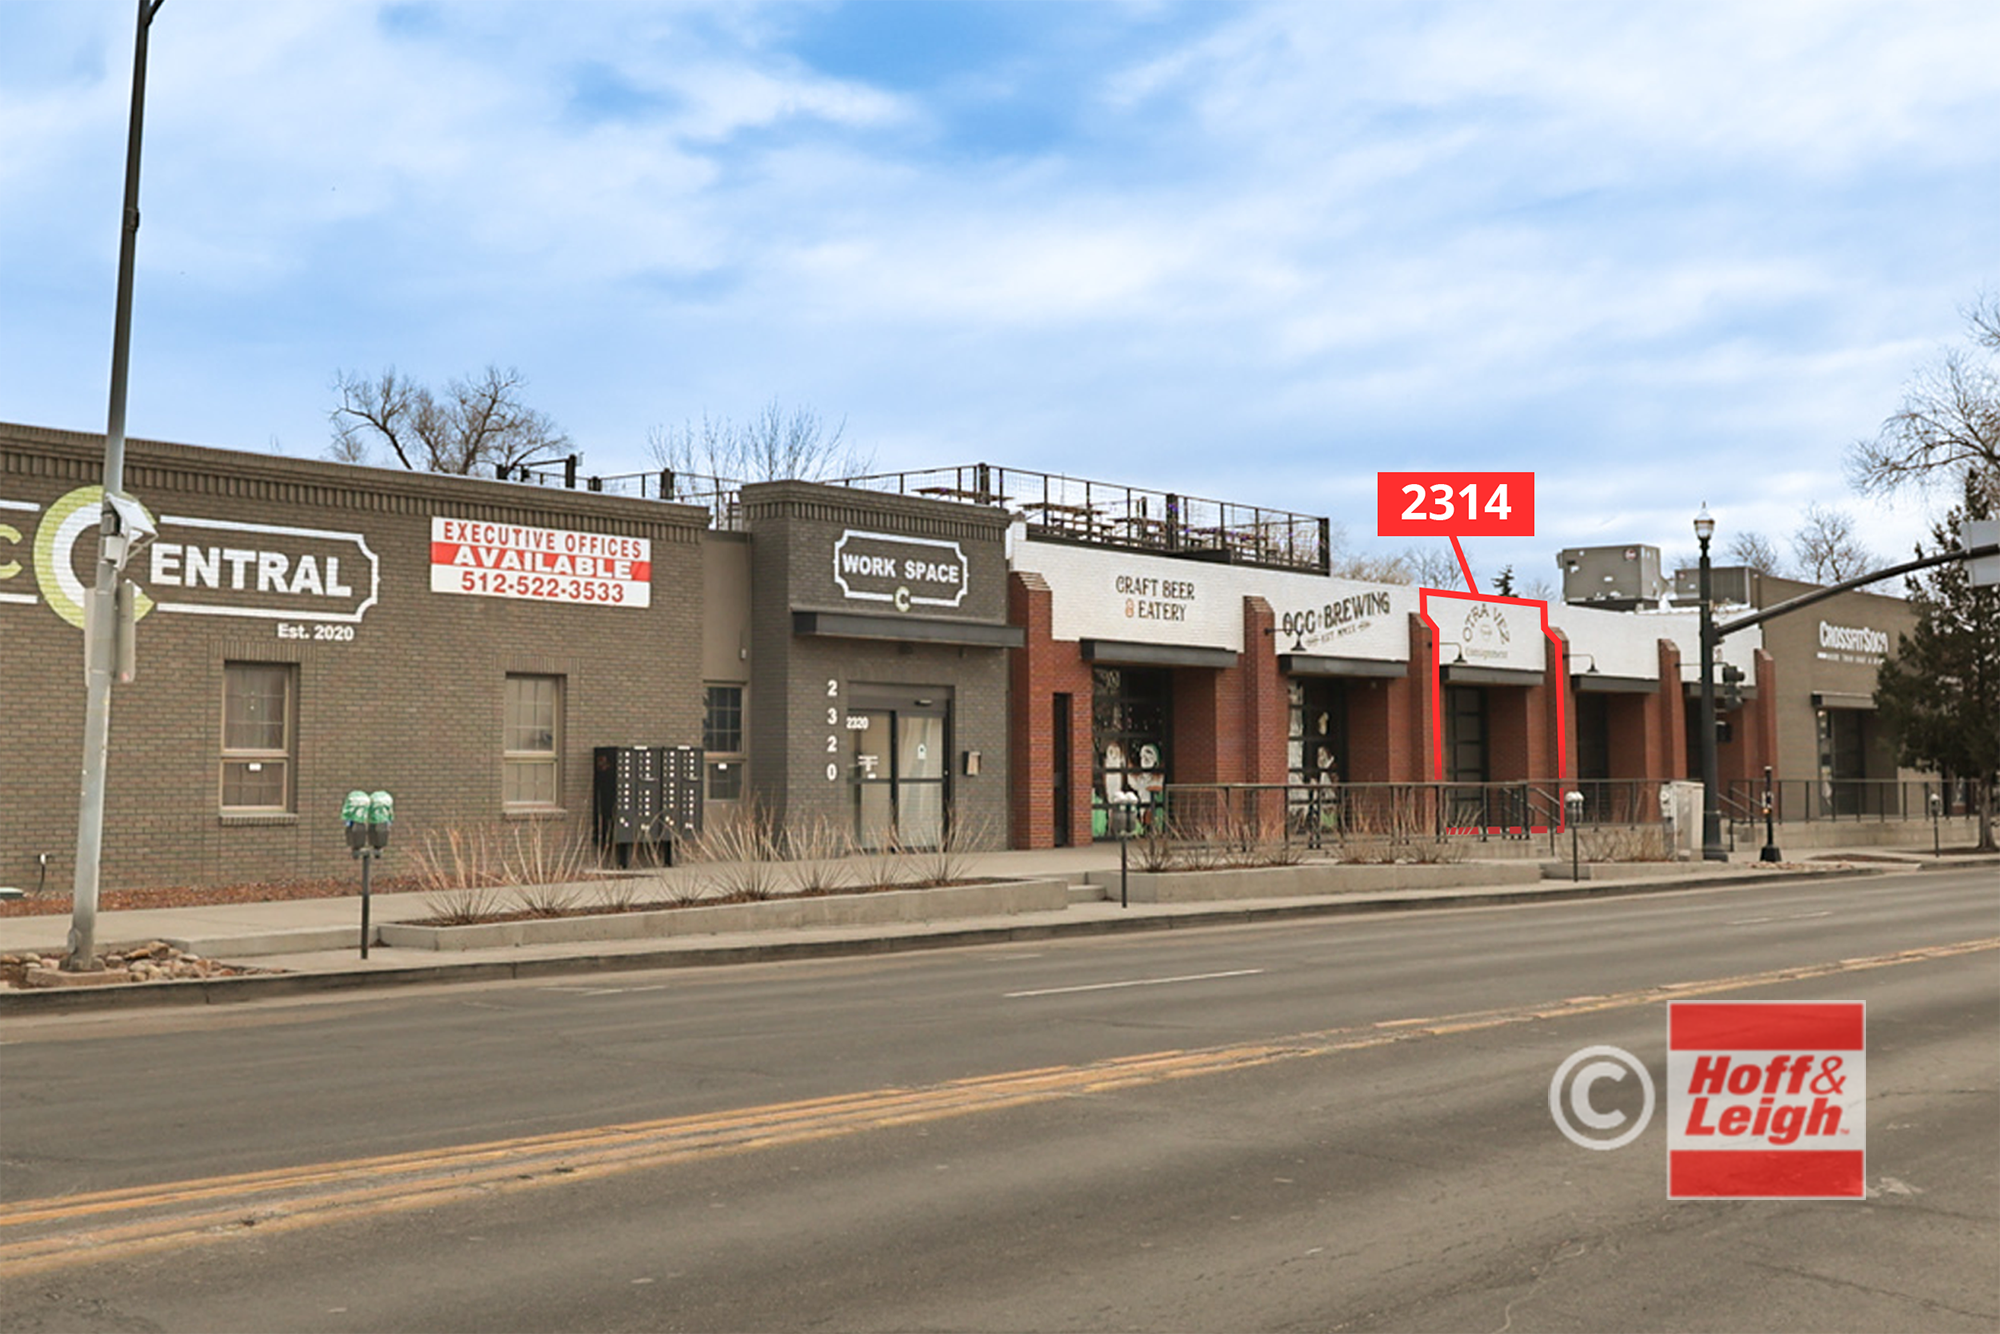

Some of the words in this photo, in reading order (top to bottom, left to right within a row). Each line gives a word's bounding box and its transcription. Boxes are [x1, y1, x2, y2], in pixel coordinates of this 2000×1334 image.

[444, 521, 556, 551] EXECUTIVE
[564, 534, 642, 559] OFFICES
[453, 545, 633, 580] AVAILABLE
[842, 553, 896, 578] WORK
[904, 560, 959, 583] SPACE
[461, 571, 624, 603] 512-522-3533
[1115, 575, 1159, 597] CRAFT
[1162, 580, 1195, 600] BEER
[1138, 600, 1187, 621] EATERY
[1323, 591, 1390, 629] BREWING
[277, 622, 309, 640] Est.
[314, 624, 354, 641] 2020
